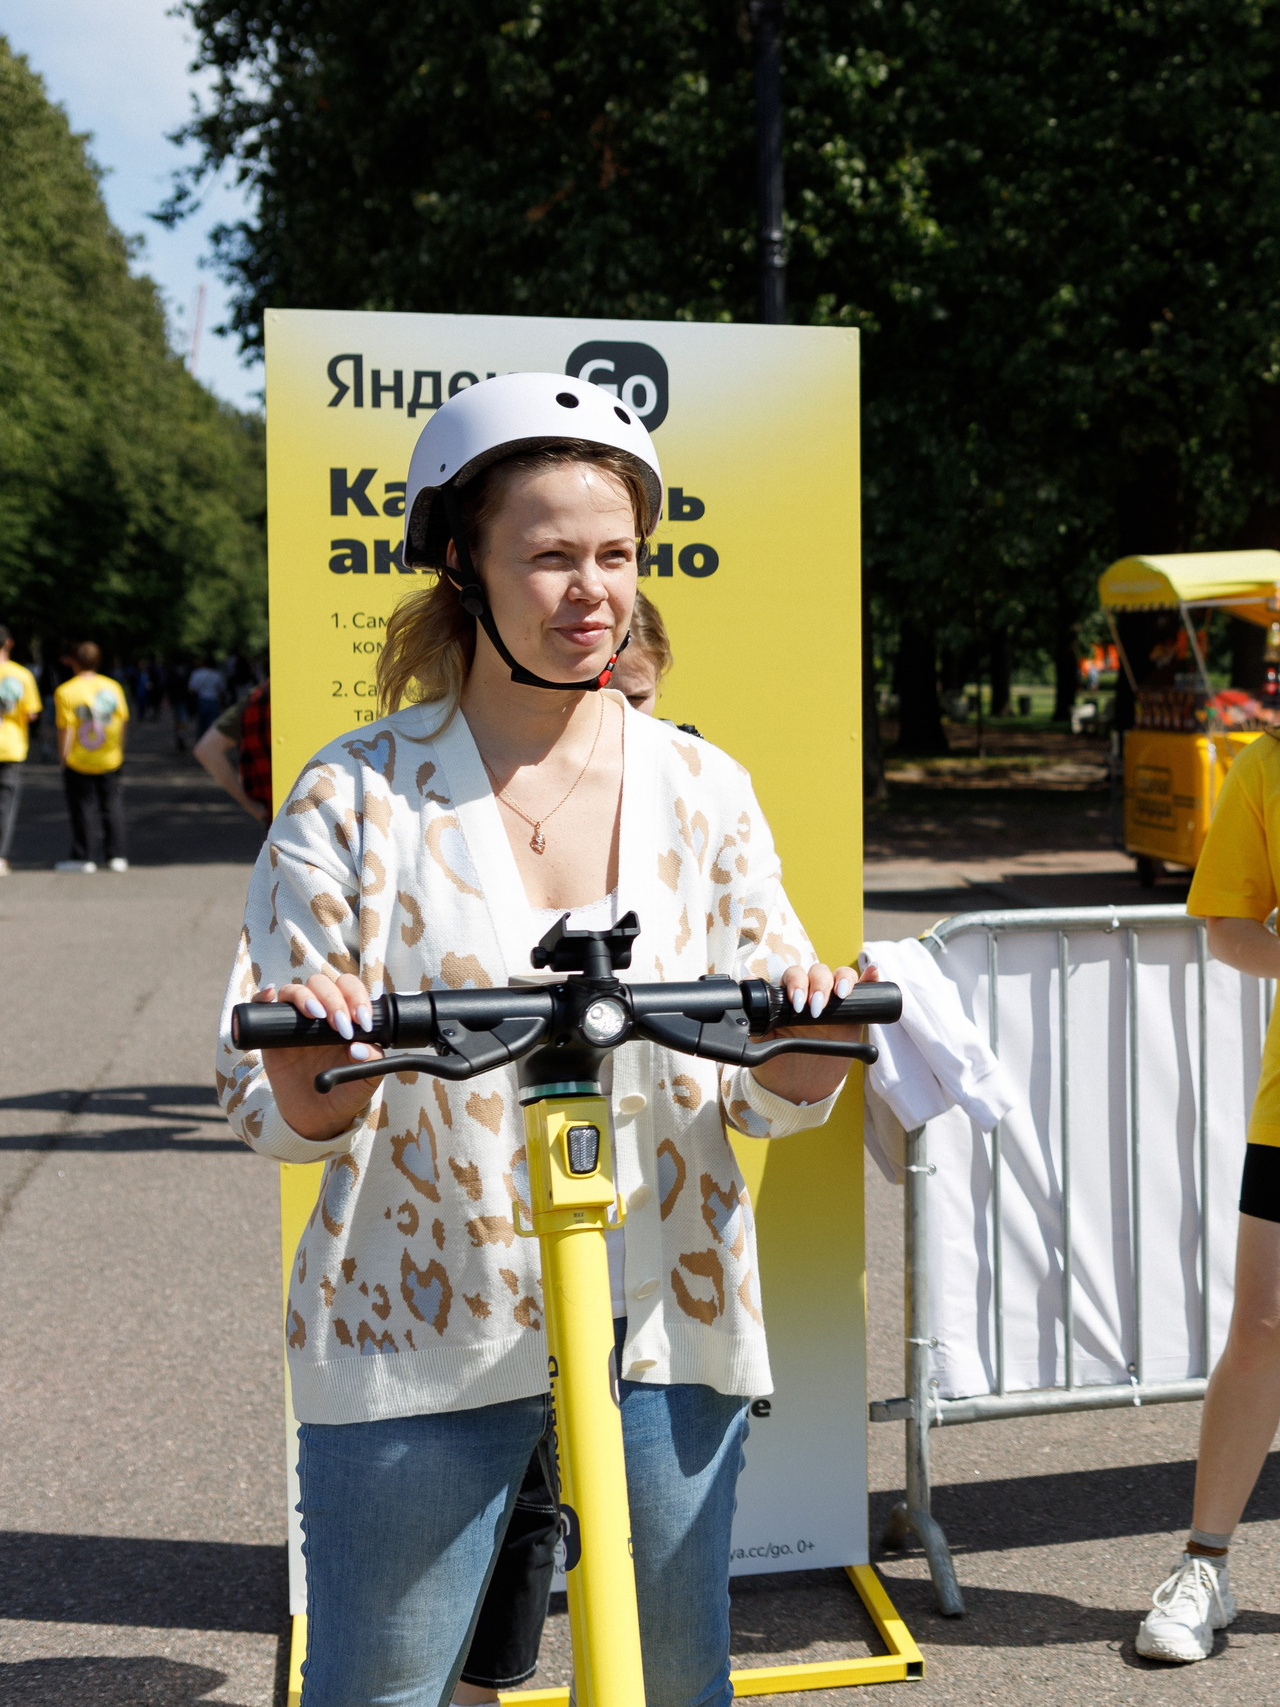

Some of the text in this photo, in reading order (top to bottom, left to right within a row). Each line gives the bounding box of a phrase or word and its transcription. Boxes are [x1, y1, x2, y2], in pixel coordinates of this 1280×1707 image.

[327, 353, 519, 418] Янде
[331, 612, 346, 629] 1.
[332, 680, 348, 697] 2.
